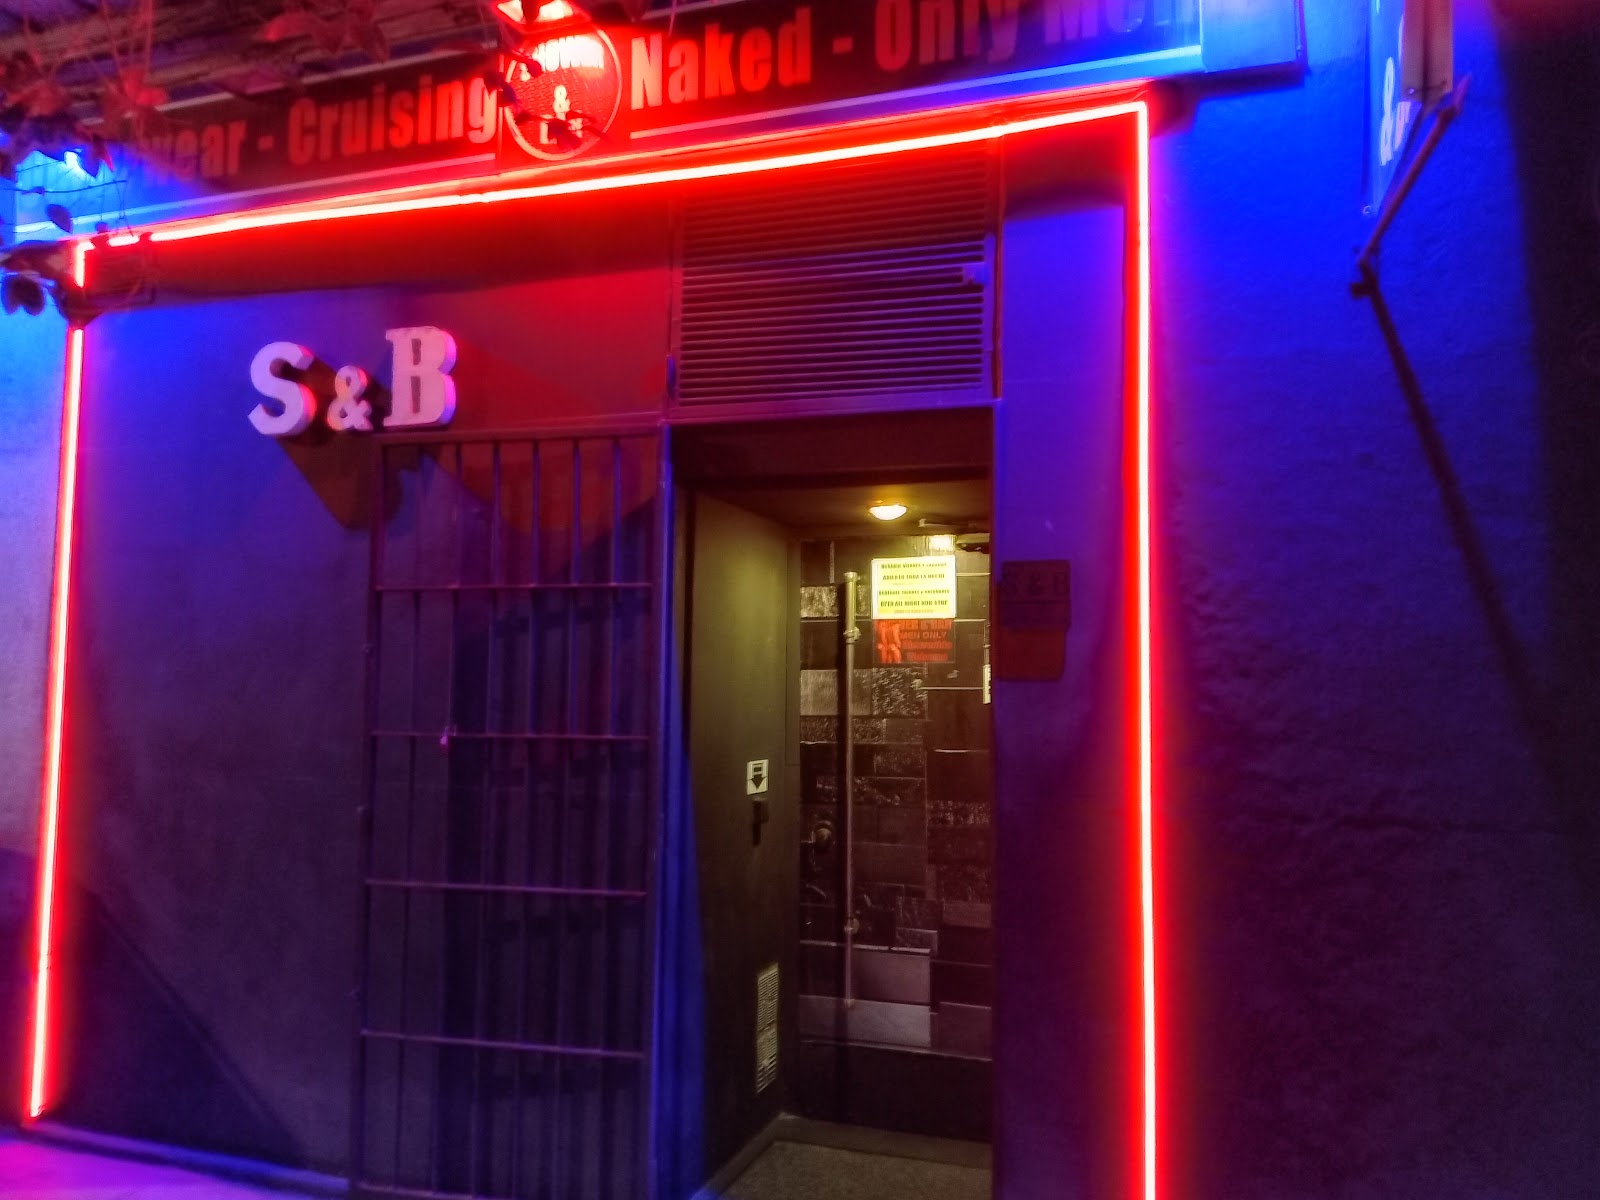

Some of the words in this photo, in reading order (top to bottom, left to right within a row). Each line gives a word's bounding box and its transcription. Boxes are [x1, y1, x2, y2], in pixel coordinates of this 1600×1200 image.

[629, 7, 812, 110] Naked
[874, 0, 1019, 72] Only
[287, 74, 497, 166] Cruising
[247, 341, 317, 437] S
[326, 365, 374, 432] &
[383, 326, 457, 429] B
[922, 631, 947, 639] ONLY
